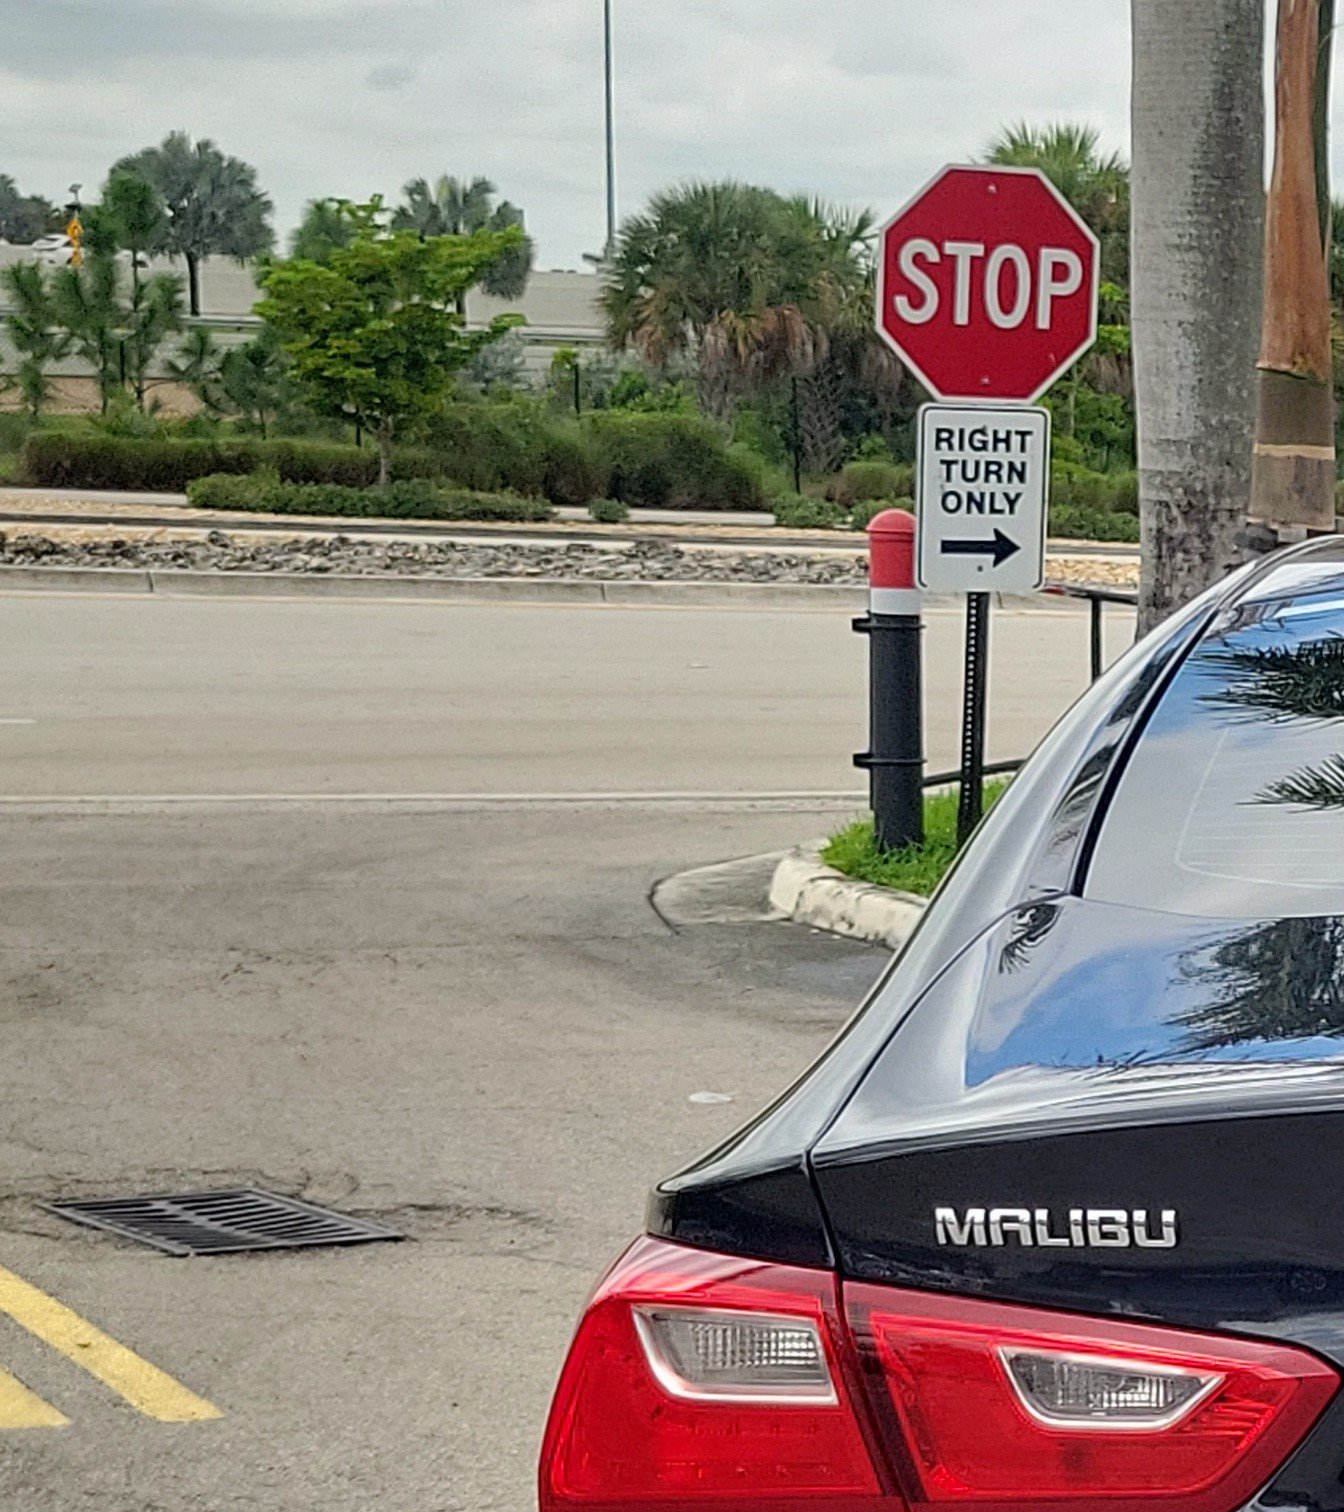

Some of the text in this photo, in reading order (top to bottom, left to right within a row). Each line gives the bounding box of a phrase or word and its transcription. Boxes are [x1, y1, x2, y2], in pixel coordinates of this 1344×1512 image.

[894, 237, 1084, 331] STOP
[934, 427, 1034, 454] RIGHT
[939, 459, 1027, 485] TURN
[940, 490, 1024, 515] ONLY
[934, 1206, 1177, 1248] MALIBU
